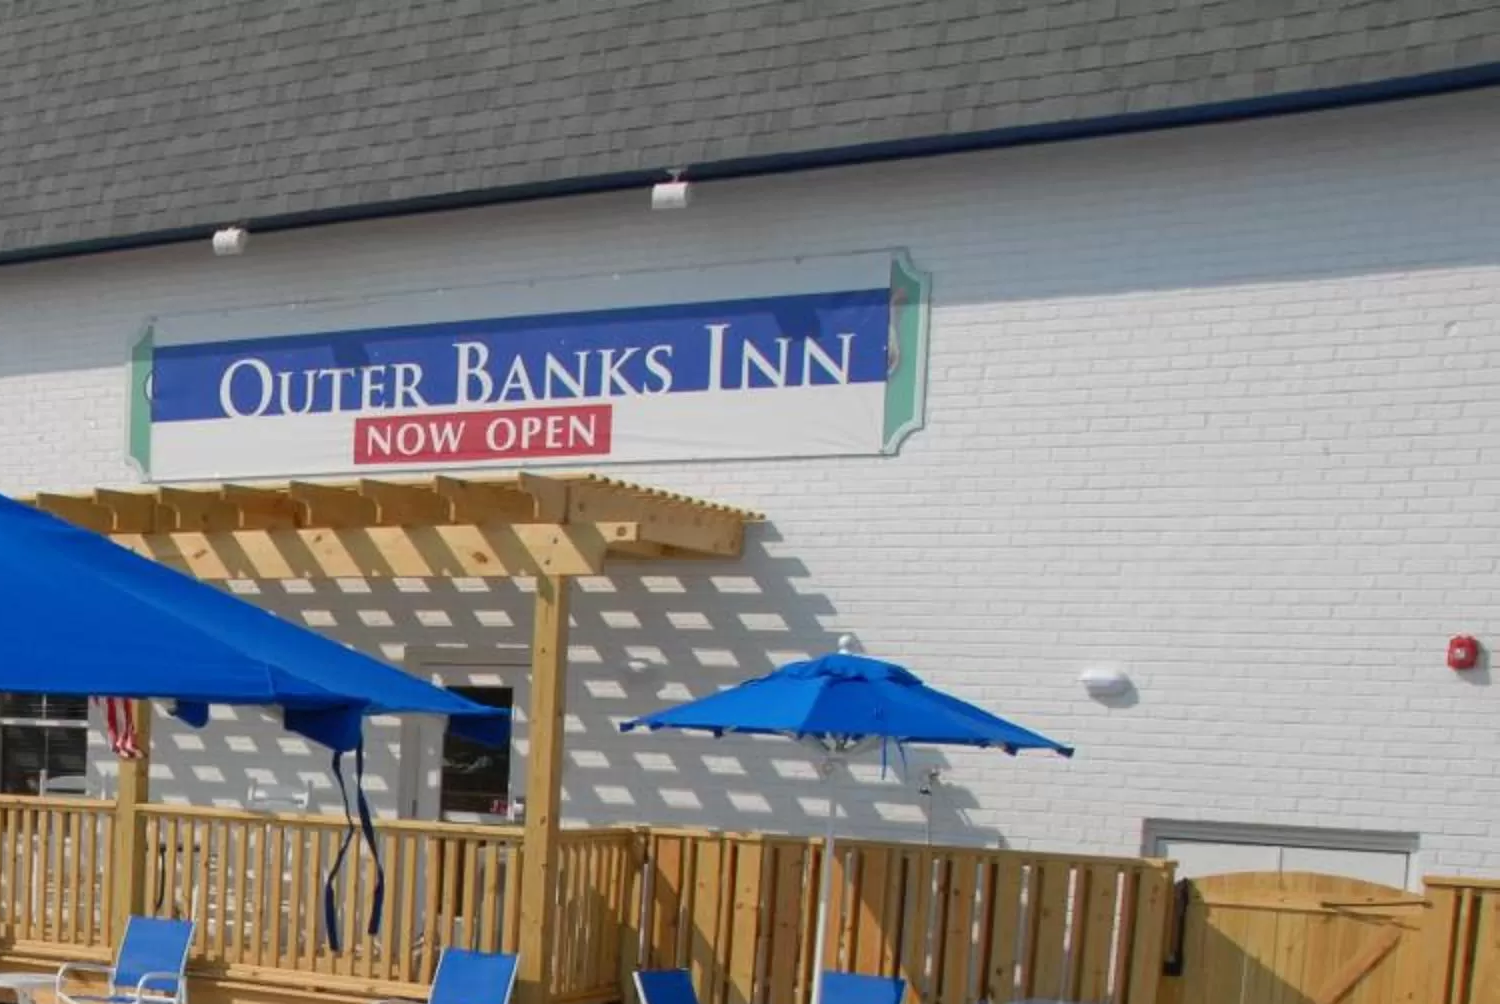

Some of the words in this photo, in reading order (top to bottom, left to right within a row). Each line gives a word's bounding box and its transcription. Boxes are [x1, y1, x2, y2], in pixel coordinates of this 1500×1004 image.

[218, 358, 427, 420] OUTER
[452, 340, 673, 404] BANKS
[705, 323, 856, 391] INN
[366, 423, 466, 457] NOW
[485, 413, 597, 452] OPEN
